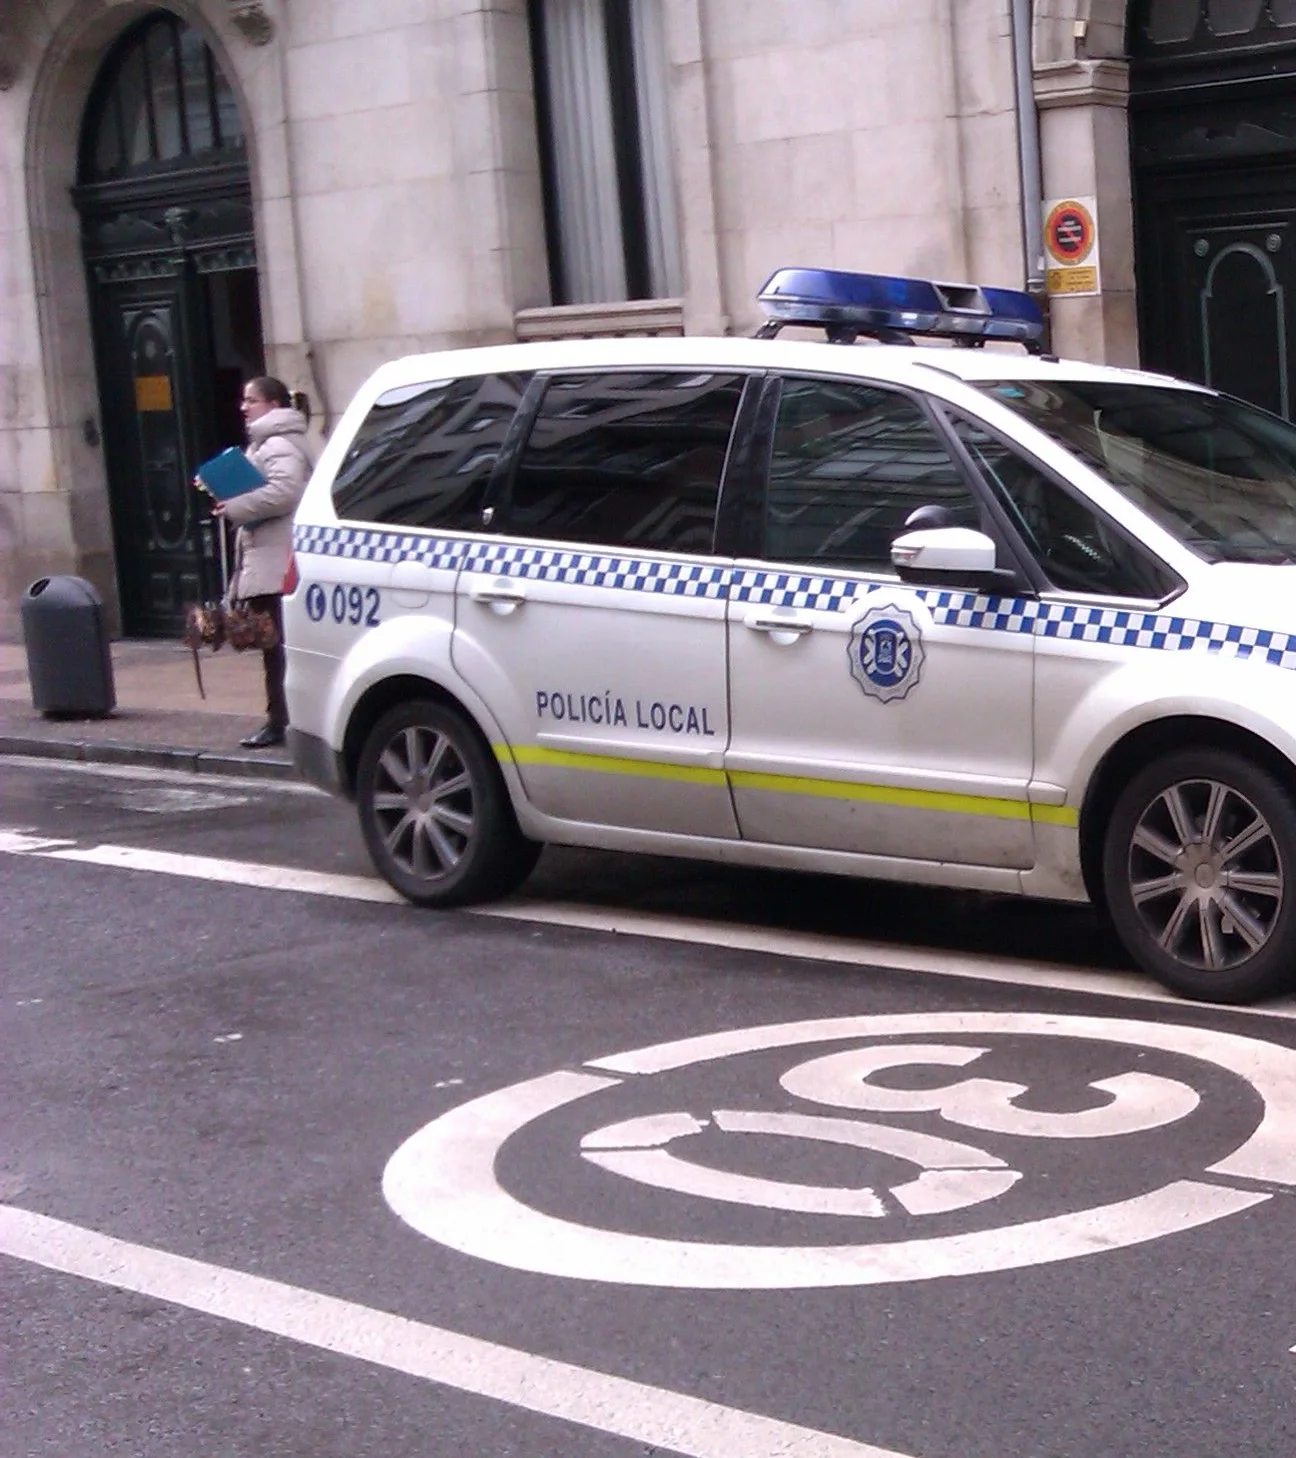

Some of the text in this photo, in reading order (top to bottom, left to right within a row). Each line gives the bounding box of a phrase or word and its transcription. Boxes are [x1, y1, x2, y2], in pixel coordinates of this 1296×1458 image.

[332, 584, 380, 627] 092
[535, 690, 715, 736] POLICÍA LOCAL
[581, 1043, 1200, 1217] 30
